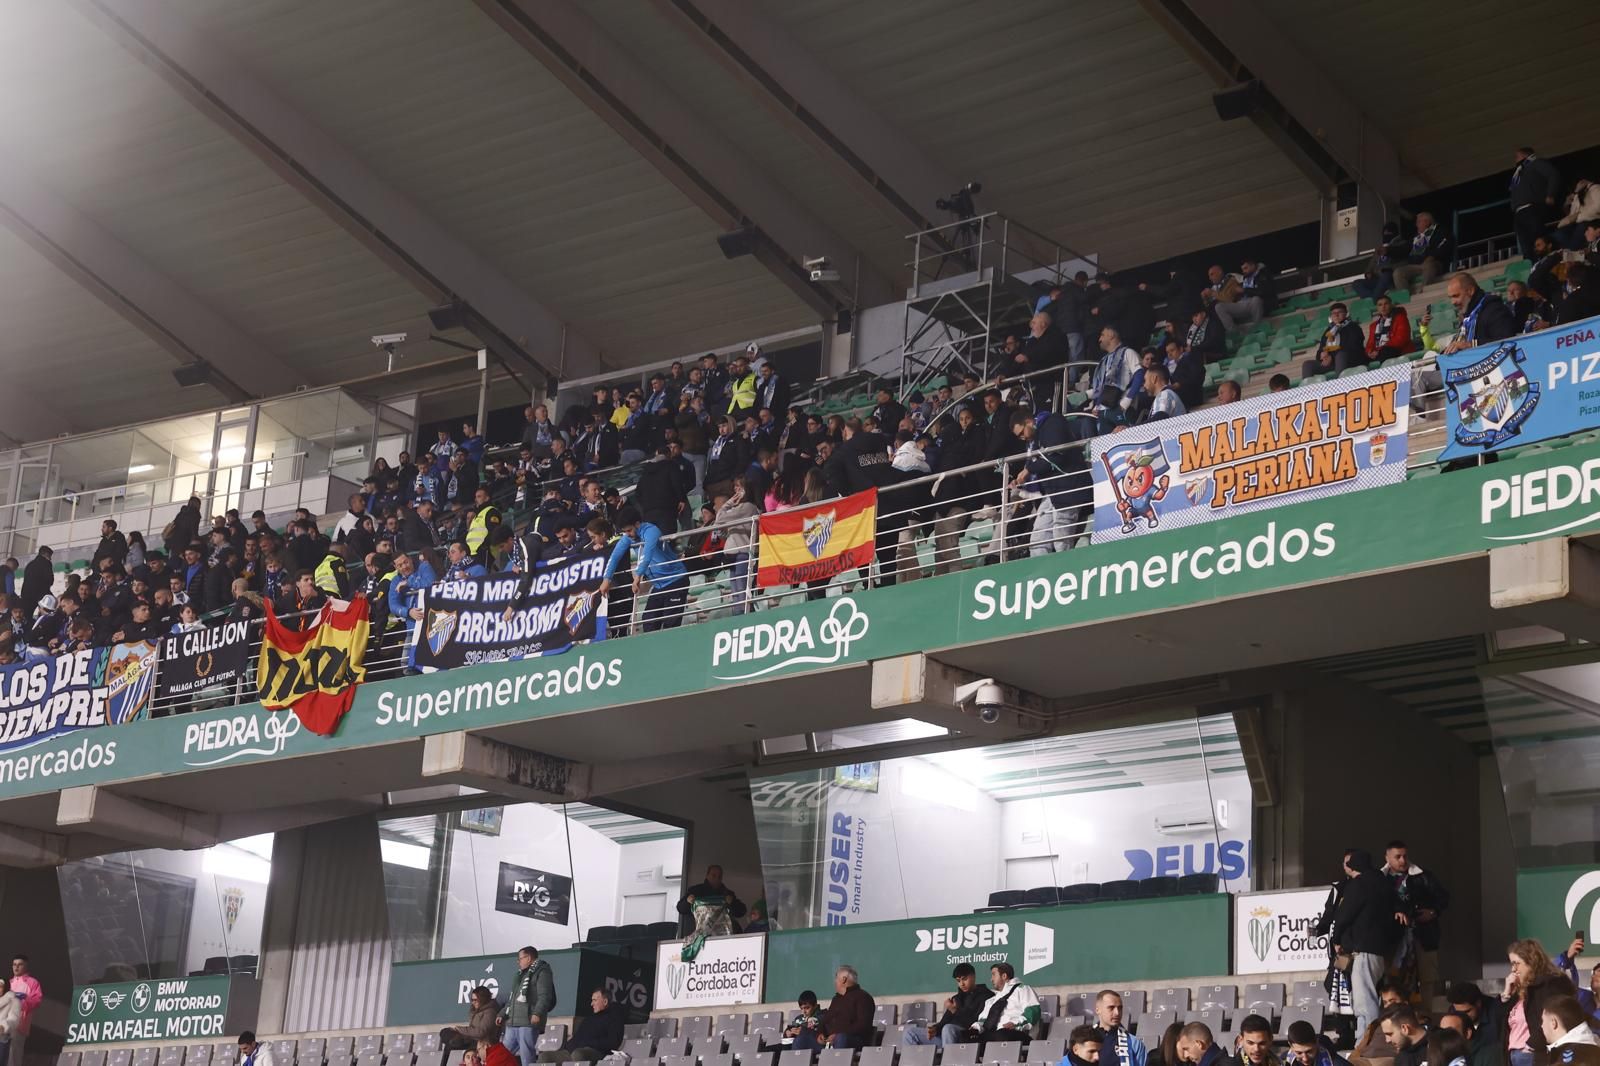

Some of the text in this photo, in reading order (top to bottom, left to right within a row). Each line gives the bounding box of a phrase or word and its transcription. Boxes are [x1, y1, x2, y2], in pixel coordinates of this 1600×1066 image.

[1343, 217, 1351, 227] 3
[1556, 329, 1595, 350] PEÑA
[1548, 351, 1600, 391] PIZ
[1178, 381, 1398, 474] MALAKATON
[1210, 439, 1358, 508] PERIANA
[482, 556, 605, 602] MAGUISTA
[971, 521, 1336, 620] Supermercados
[455, 598, 565, 643] ARCHIDONA
[166, 637, 179, 661] EL
[52, 649, 93, 693] DE
[194, 678, 207, 689] CLUB
[208, 675, 216, 685] DE
[376, 656, 622, 727] Supermercados
[852, 818, 867, 915] Smart Industry
[1124, 840, 1251, 881] DEUS
[914, 923, 1009, 952] DEUSER
[688, 956, 757, 976] Fundación
[946, 952, 1008, 965] Smart Industry
[157, 981, 188, 995] BMW
[687, 972, 757, 992] Córdoba CF
[154, 995, 222, 1013] MOTORRAD
[67, 1014, 224, 1043] SAN RAFAEL MOTOR
